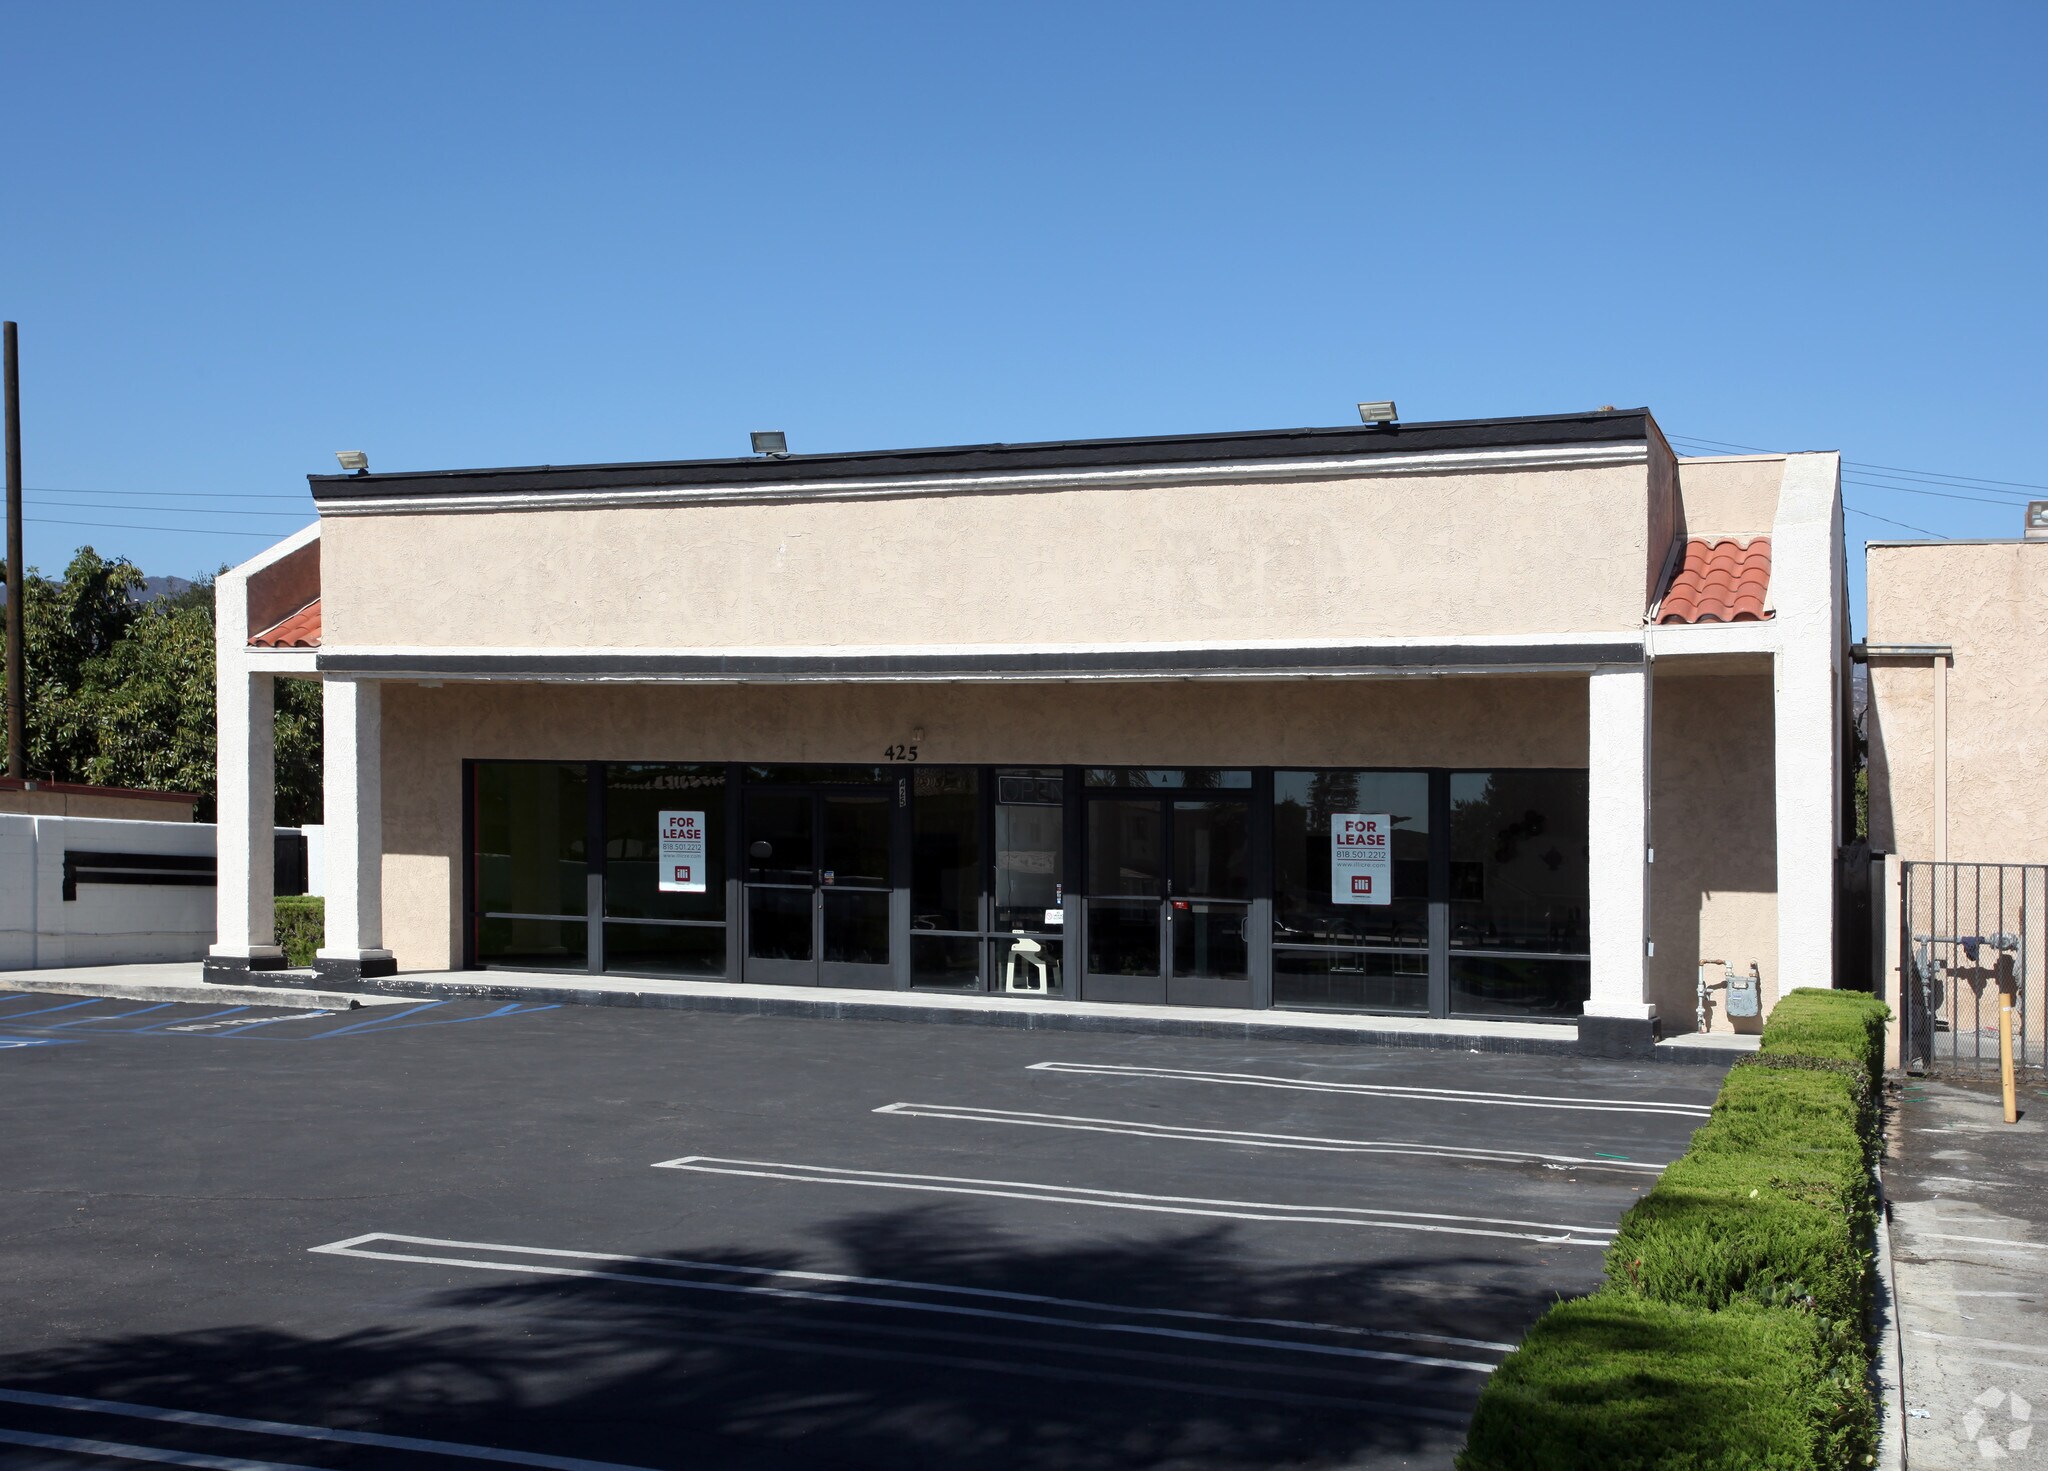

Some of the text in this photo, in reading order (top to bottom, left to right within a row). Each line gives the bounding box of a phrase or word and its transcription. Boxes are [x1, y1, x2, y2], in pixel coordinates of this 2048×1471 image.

[884, 744, 918, 762] 425
[1161, 774, 1168, 783] A
[669, 817, 695, 828] FOR
[1345, 820, 1377, 832] FOR
[663, 828, 702, 840] LEASE
[1336, 834, 1385, 846] LEASE
[662, 843, 702, 851] 818.501.2212
[1336, 850, 1386, 859] 818.501.2212
[1354, 879, 1369, 891] illi
